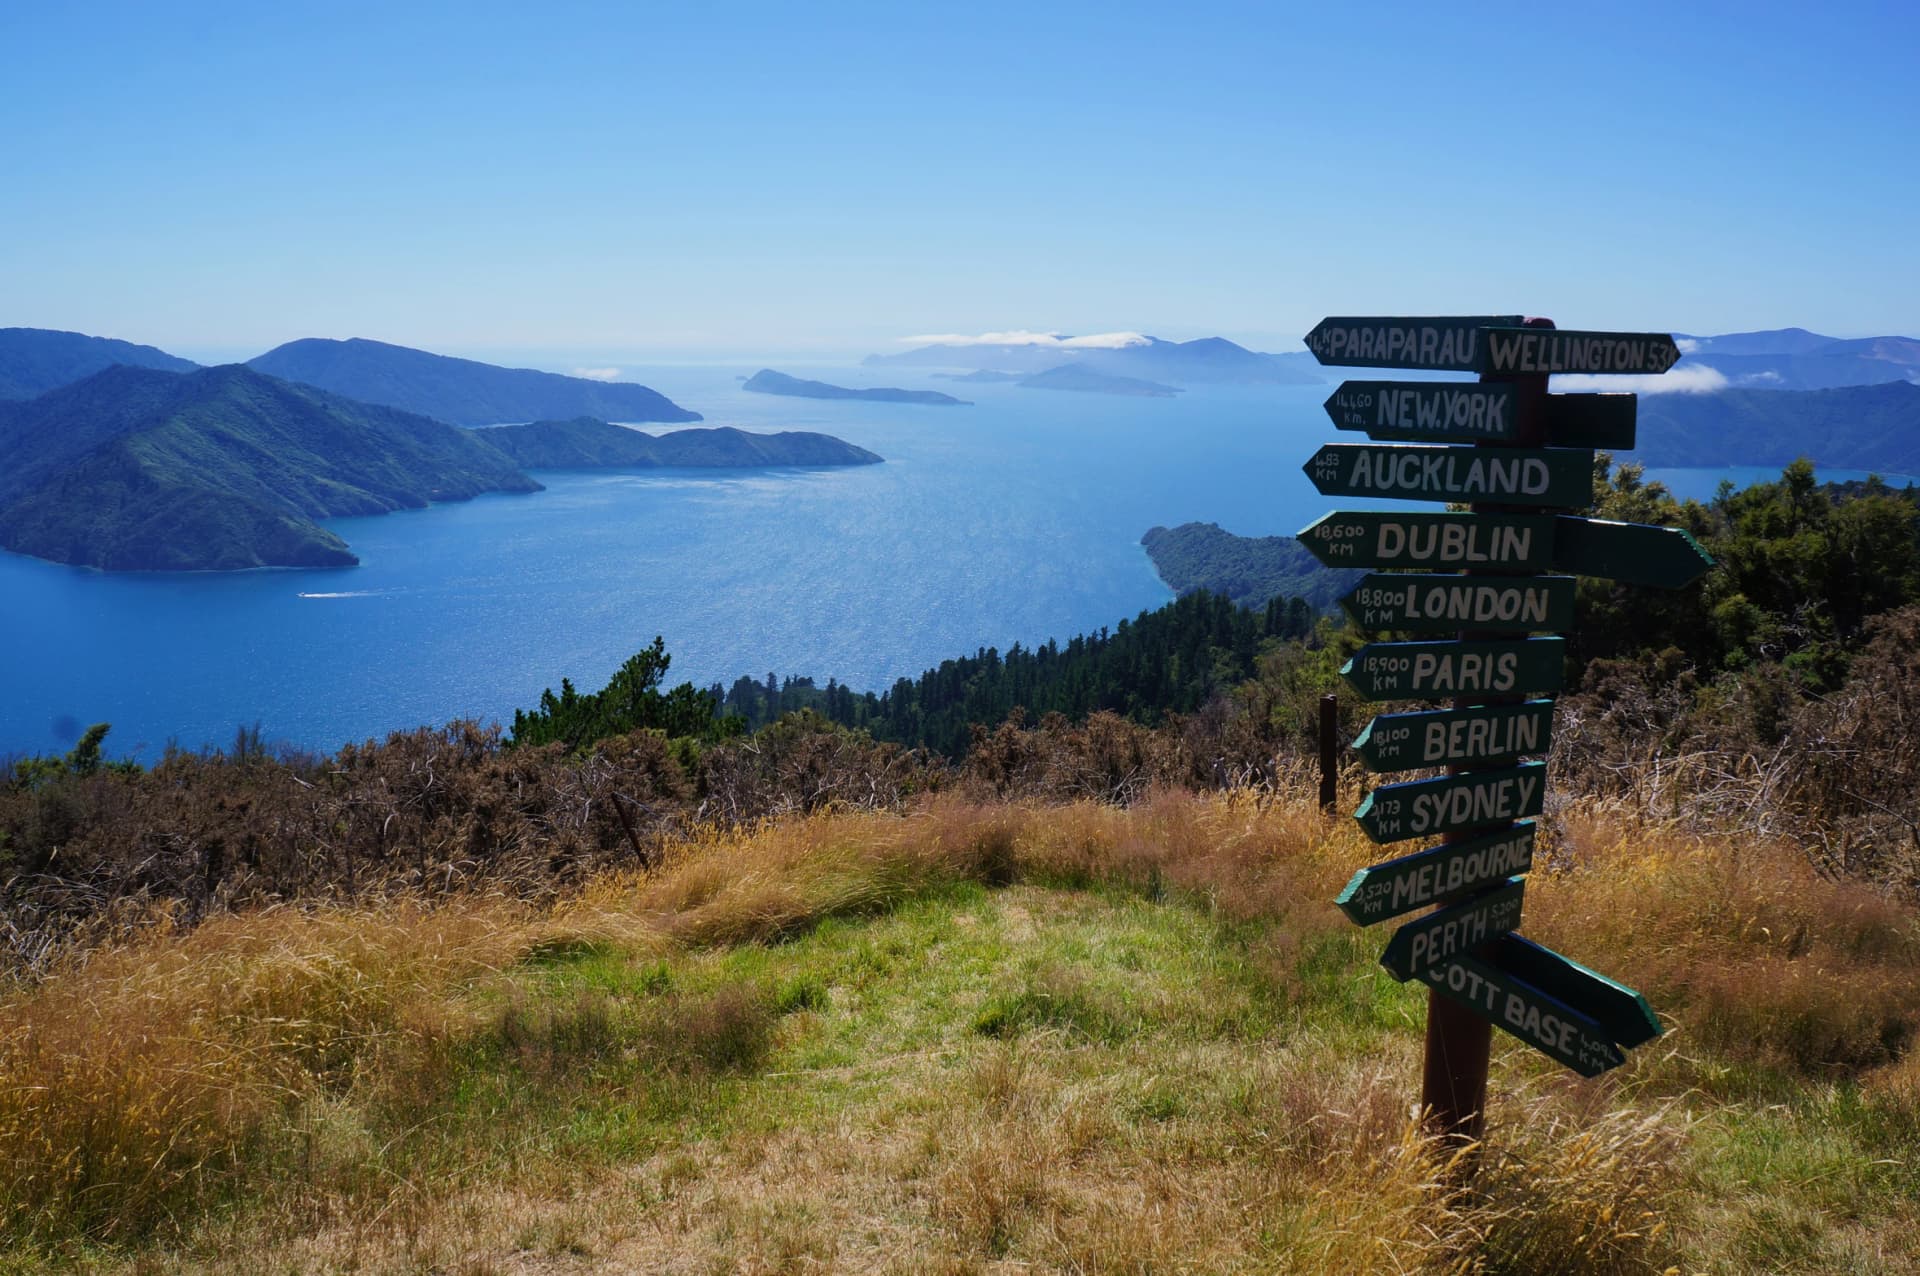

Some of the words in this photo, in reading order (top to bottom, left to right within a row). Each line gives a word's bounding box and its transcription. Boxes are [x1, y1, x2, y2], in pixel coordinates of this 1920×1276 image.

[1489, 332, 1645, 372] WELLINGTON
[1349, 449, 1550, 495] AUCKLAND
[1329, 543, 1353, 556] KM
[1376, 523, 1531, 562] DUBLIN
[1405, 584, 1548, 623] LONDON
[1372, 675, 1398, 692] KM
[1412, 652, 1518, 691] PARIS
[1423, 713, 1539, 761] BERLIN
[1410, 775, 1536, 833] SYDNEY
[1378, 818, 1401, 836] KM
[1391, 833, 1533, 910] MELBOURNE
[1410, 906, 1488, 973] PERTH
[1504, 992, 1579, 1057] BASE
